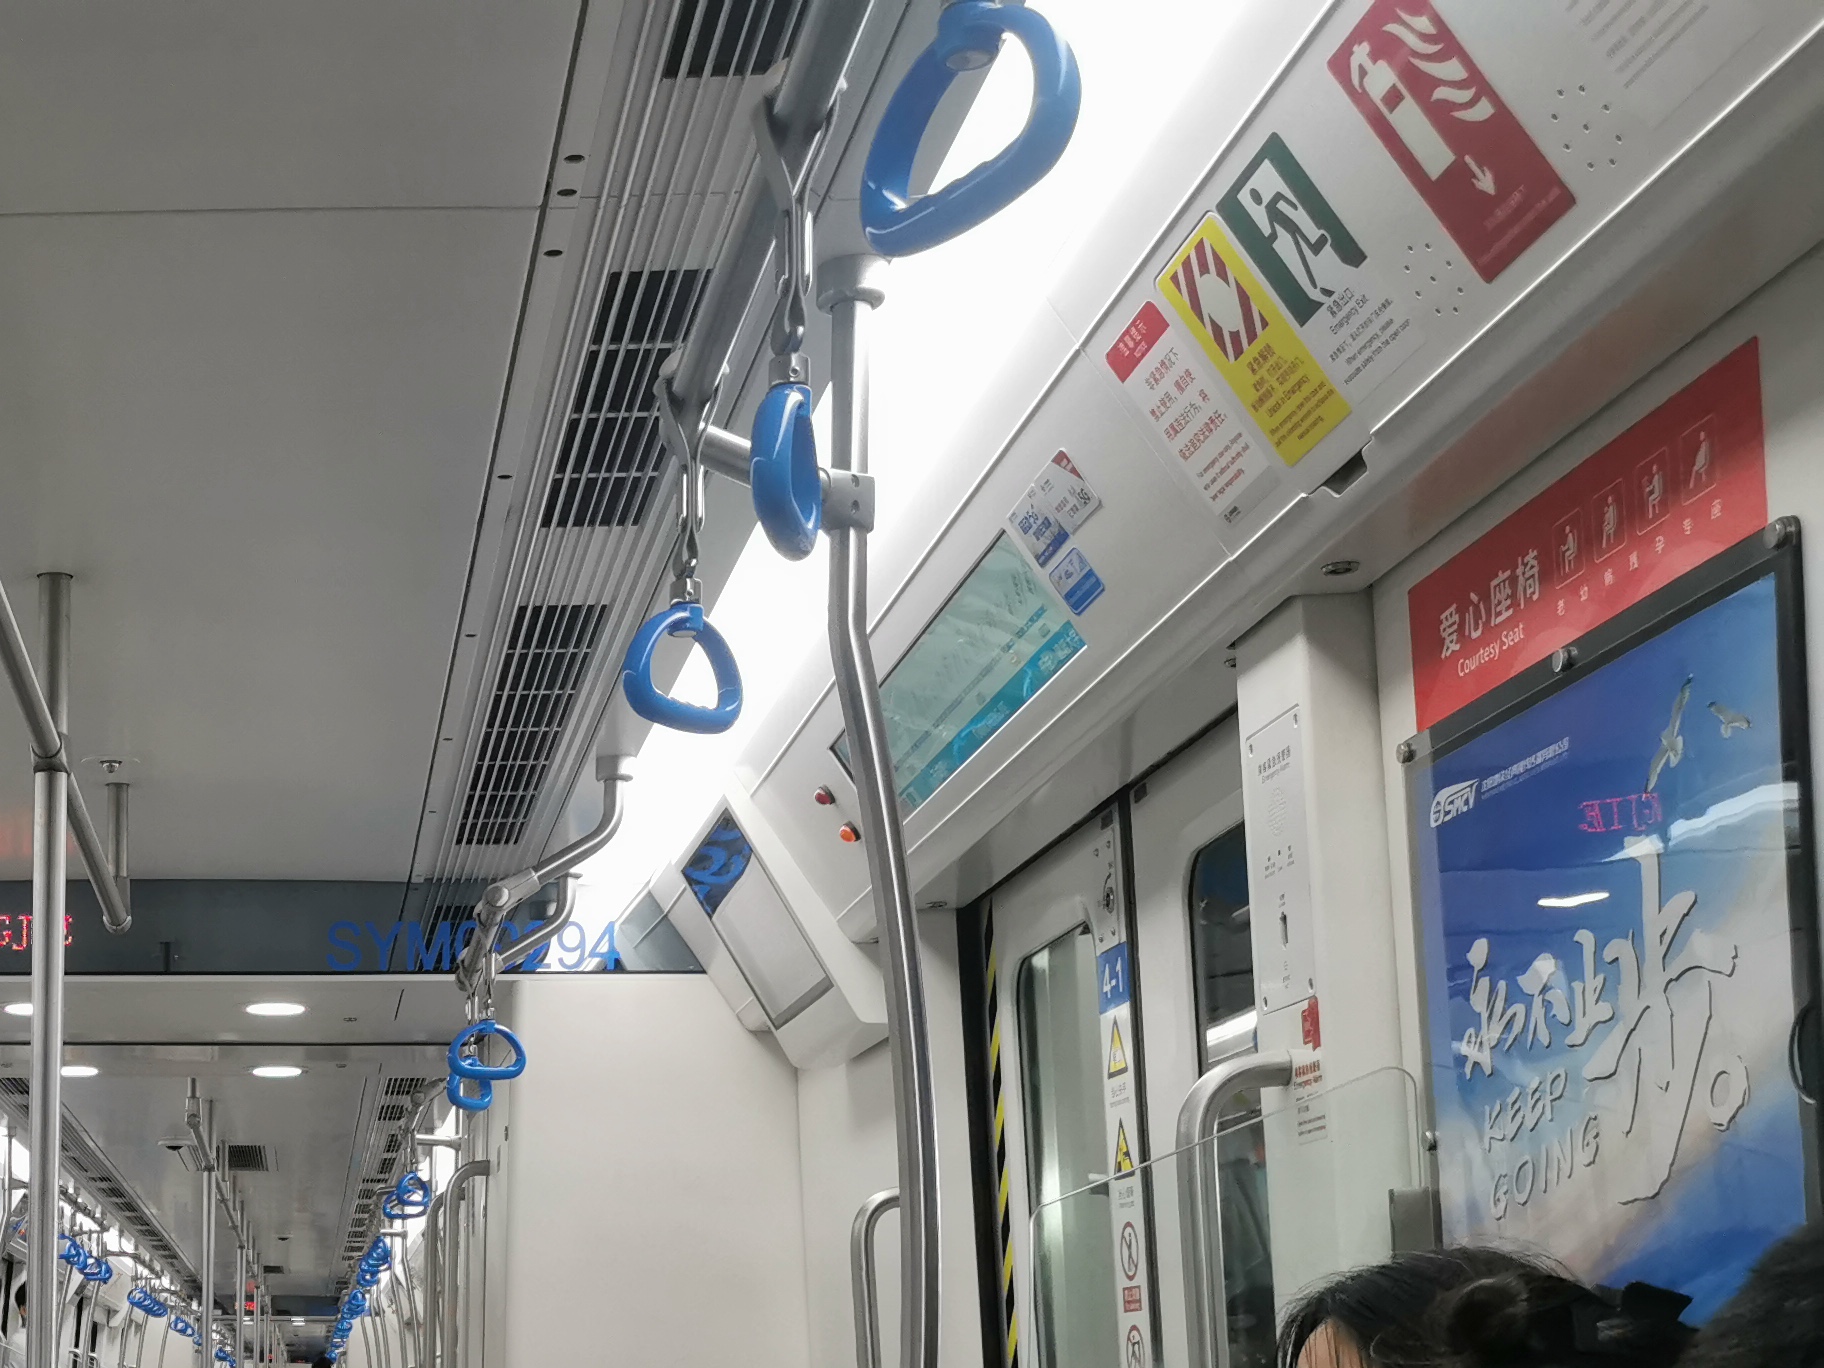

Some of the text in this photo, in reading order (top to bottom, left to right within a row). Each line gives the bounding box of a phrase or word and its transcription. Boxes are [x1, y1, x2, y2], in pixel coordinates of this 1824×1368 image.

[1439, 549, 1541, 660] 爱心座椅
[1457, 622, 1526, 678] Courtesy Seat
[1443, 782, 1478, 823] SMCV
[1102, 956, 1124, 999] 4-1
[1484, 1066, 1568, 1154] KEEP
[1489, 1113, 1601, 1222] GOING
